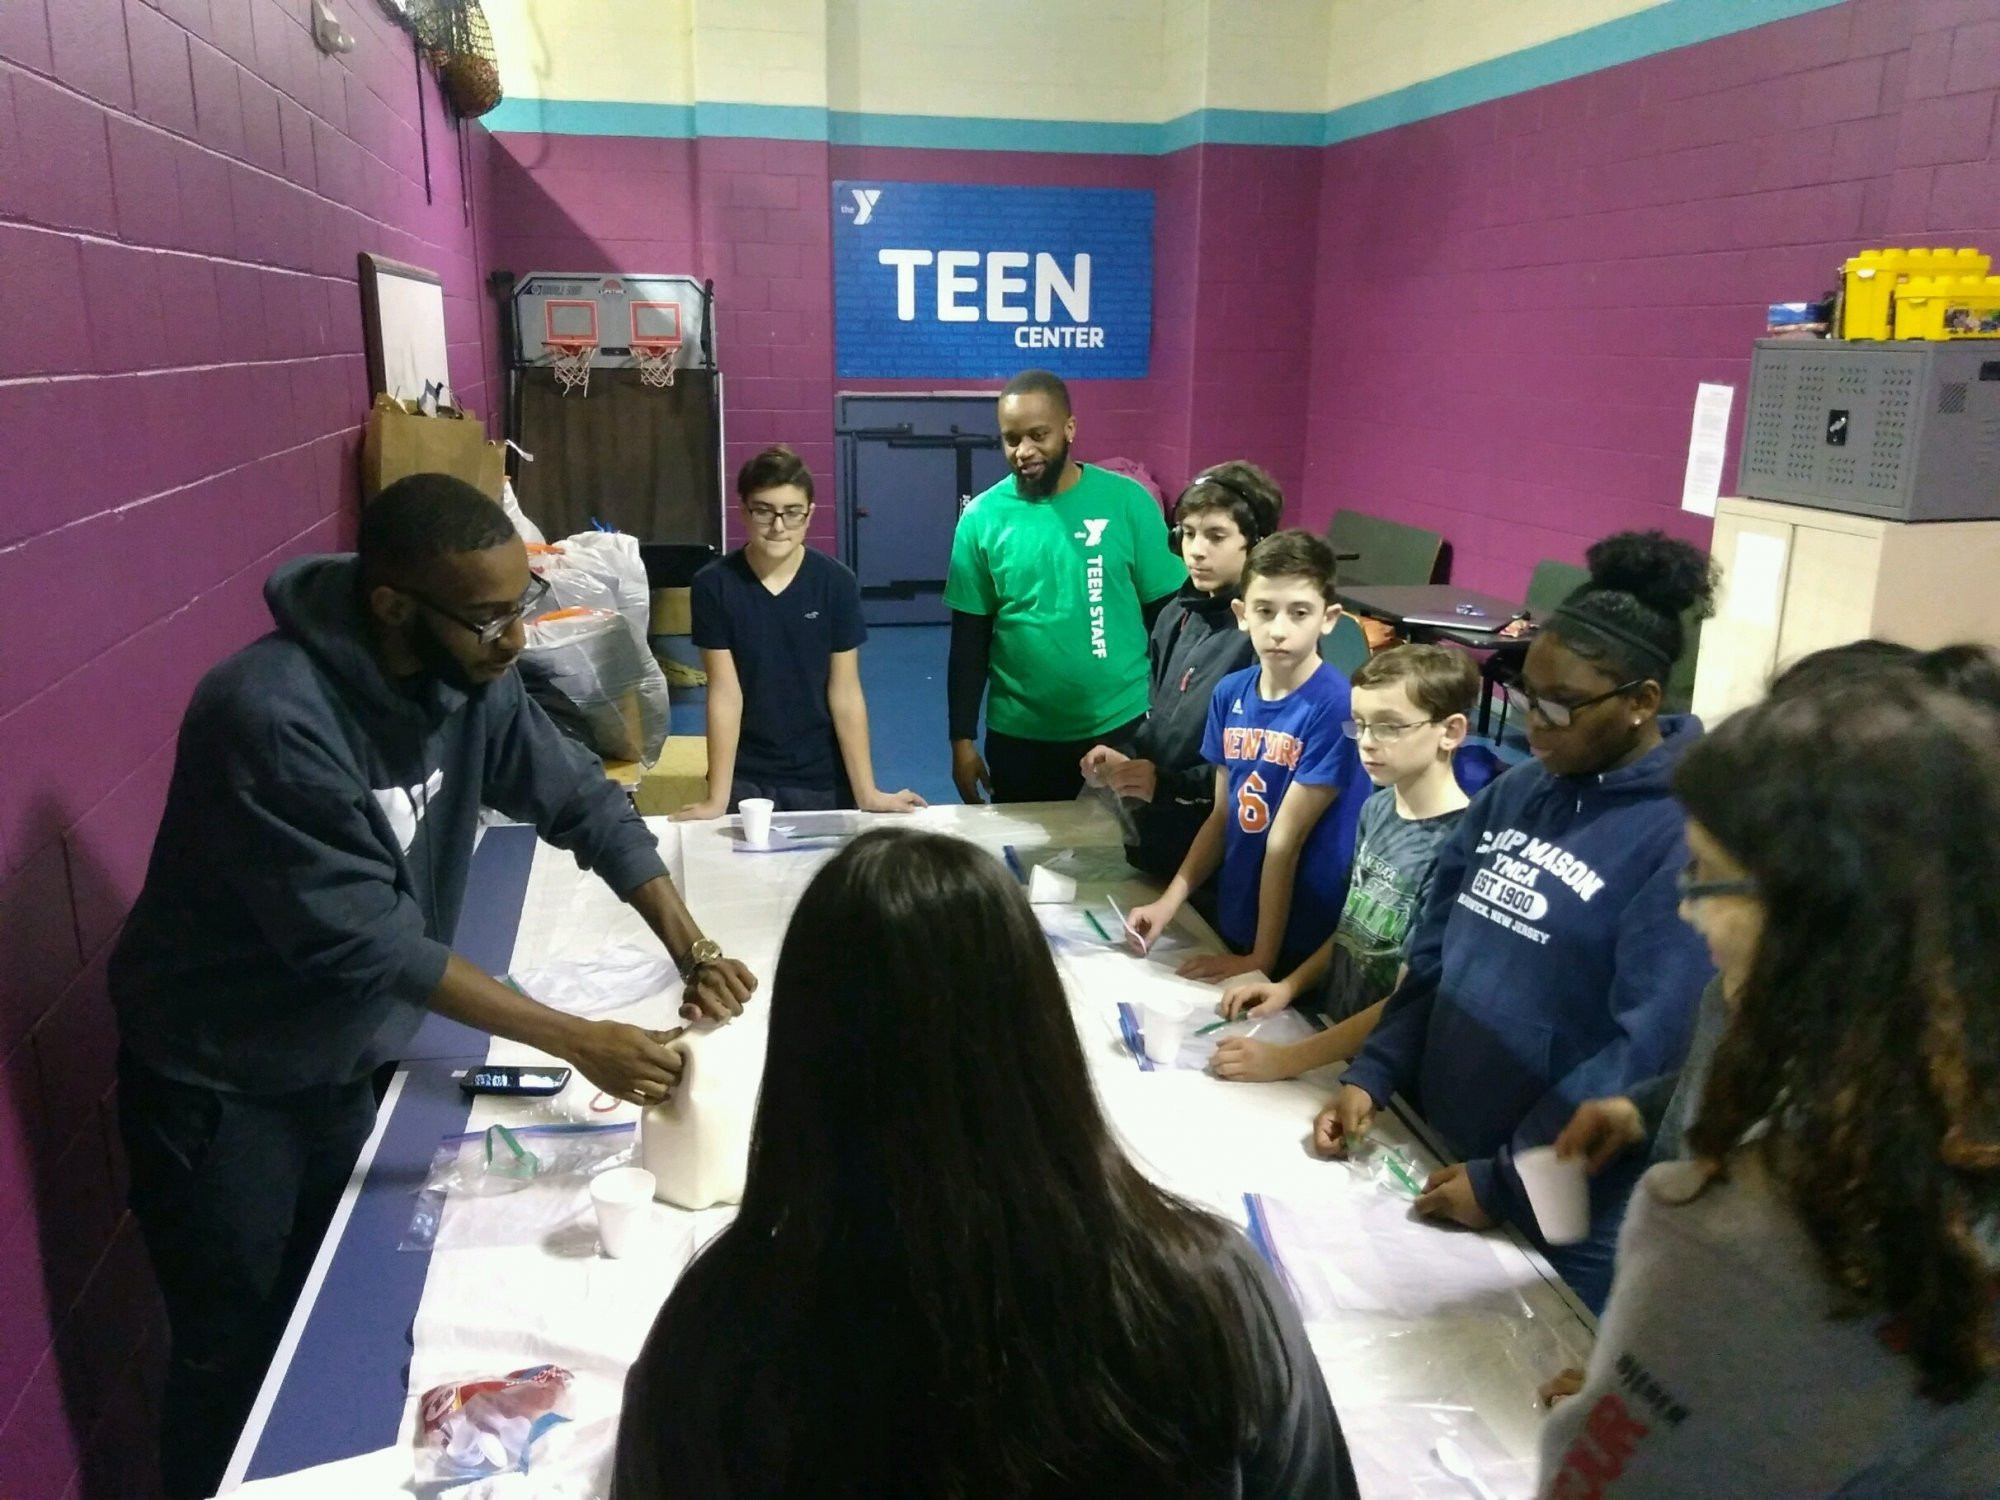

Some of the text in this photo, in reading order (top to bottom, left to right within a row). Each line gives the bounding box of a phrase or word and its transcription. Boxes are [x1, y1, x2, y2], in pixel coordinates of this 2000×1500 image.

[841, 190, 881, 225] the Y
[878, 249, 1091, 322] TEEN
[1014, 326, 1104, 348] CENTER
[1083, 518, 1110, 546] Y
[1087, 554, 1107, 659] TEEN STAFF
[1237, 771, 1270, 833] 6
[1492, 852, 1540, 887] YMCA
[1519, 837, 1605, 902] MASON
[1474, 872, 1534, 913] EST 1900
[1490, 908, 1513, 928] NEW
[1512, 920, 1551, 945] JERSEY
